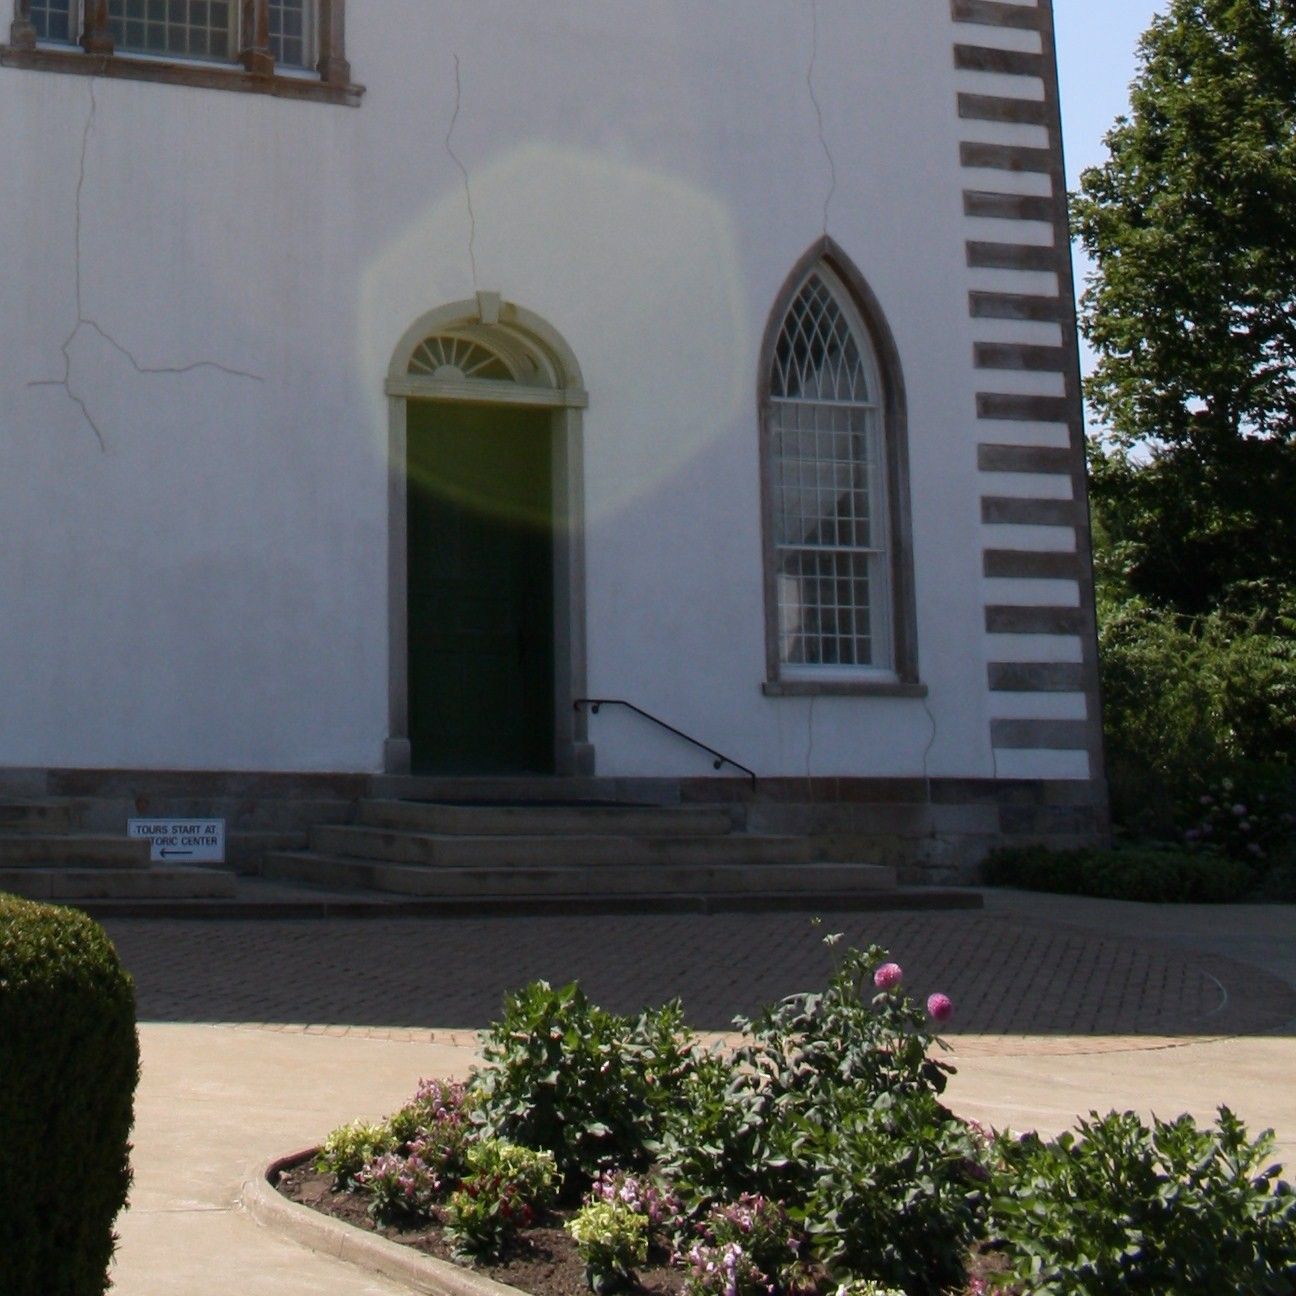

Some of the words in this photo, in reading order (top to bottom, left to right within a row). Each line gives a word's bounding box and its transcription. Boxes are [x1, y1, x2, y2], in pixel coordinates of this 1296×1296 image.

[136, 825, 167, 834] TOURS
[172, 825, 200, 834] START
[205, 825, 216, 834] AT
[182, 836, 217, 846] CENTER
